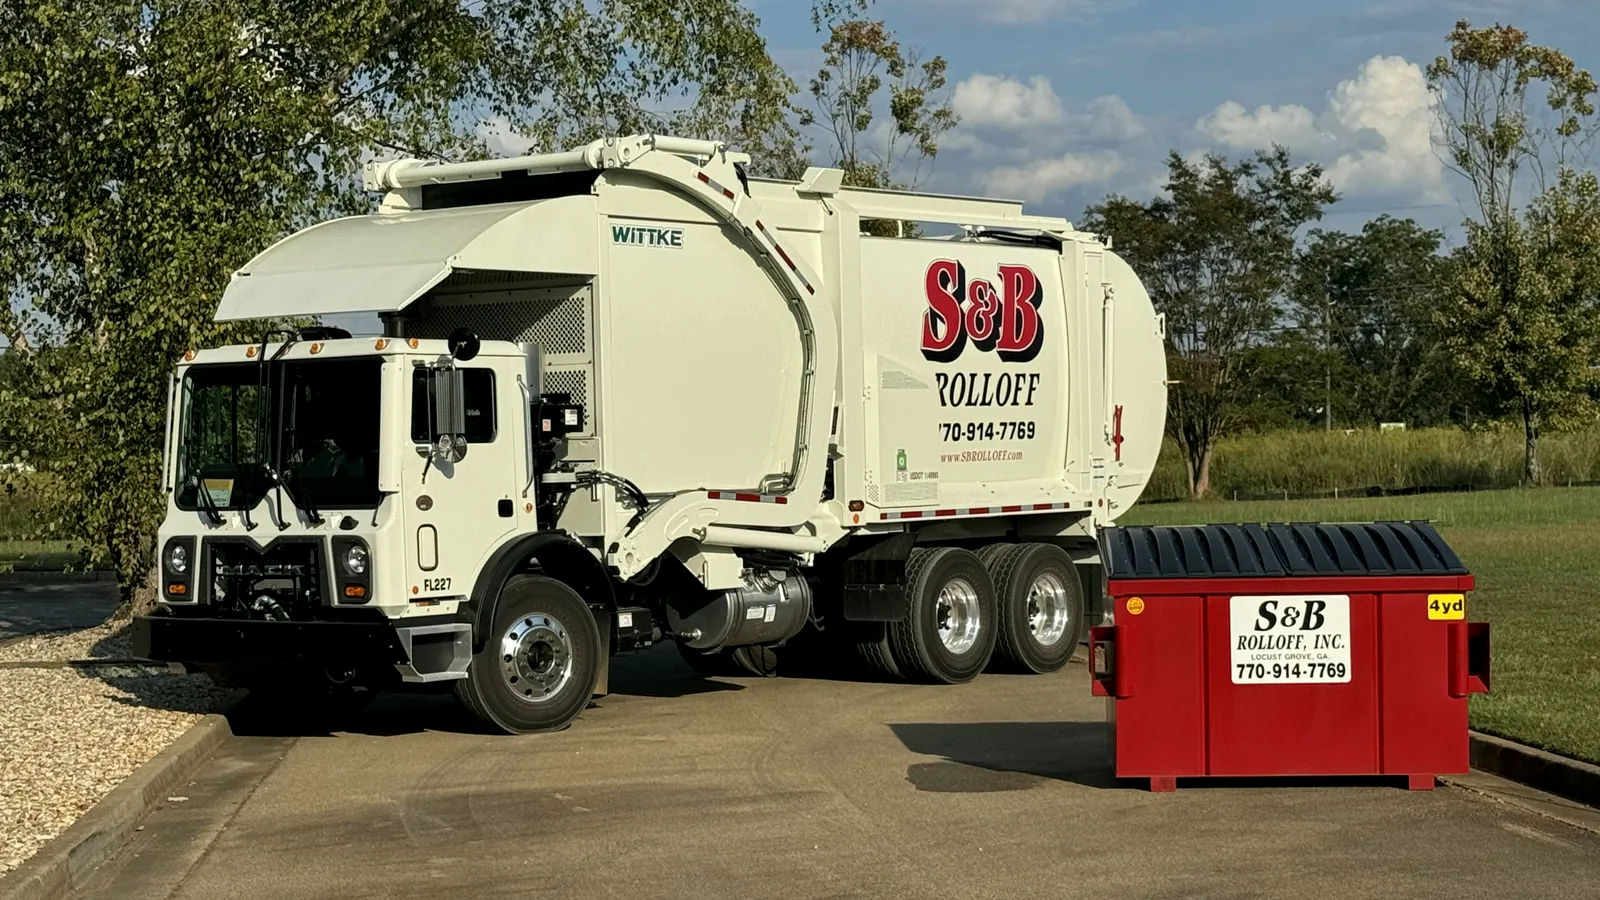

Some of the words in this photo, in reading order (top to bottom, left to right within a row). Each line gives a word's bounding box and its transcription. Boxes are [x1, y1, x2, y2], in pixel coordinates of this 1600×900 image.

[920, 258, 1044, 363] S&B
[934, 372, 1041, 408] ROLLOFF
[938, 420, 1036, 442] 70-914-7769
[424, 577, 452, 592] FL227
[1253, 599, 1327, 632] S&B
[1236, 634, 1308, 652] ROLLOFF,
[1314, 633, 1346, 650] INC.
[1251, 653, 1282, 661] LOCUST
[1284, 652, 1315, 661] GROVE,
[1236, 662, 1347, 679] 770-914-7769
